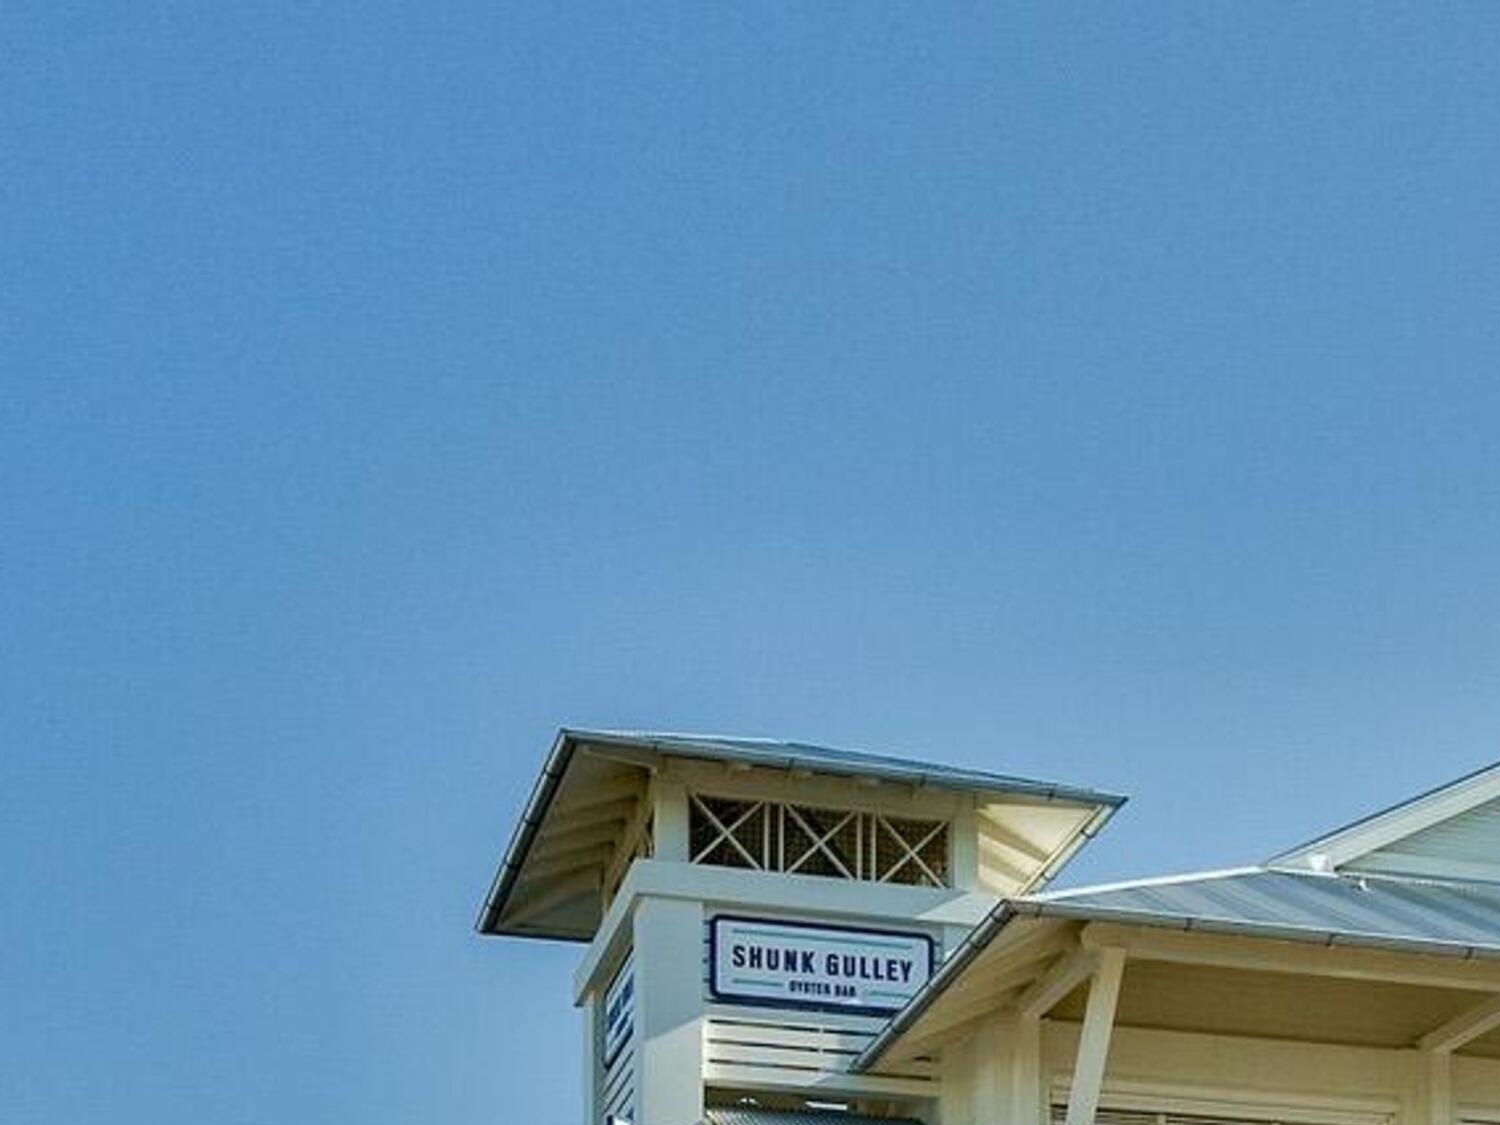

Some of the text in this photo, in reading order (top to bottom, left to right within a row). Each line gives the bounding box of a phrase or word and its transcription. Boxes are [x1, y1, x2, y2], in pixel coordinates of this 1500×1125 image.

[732, 945, 912, 983] SHUNK GULLEY
[789, 979, 857, 998] OYSTER BAR
